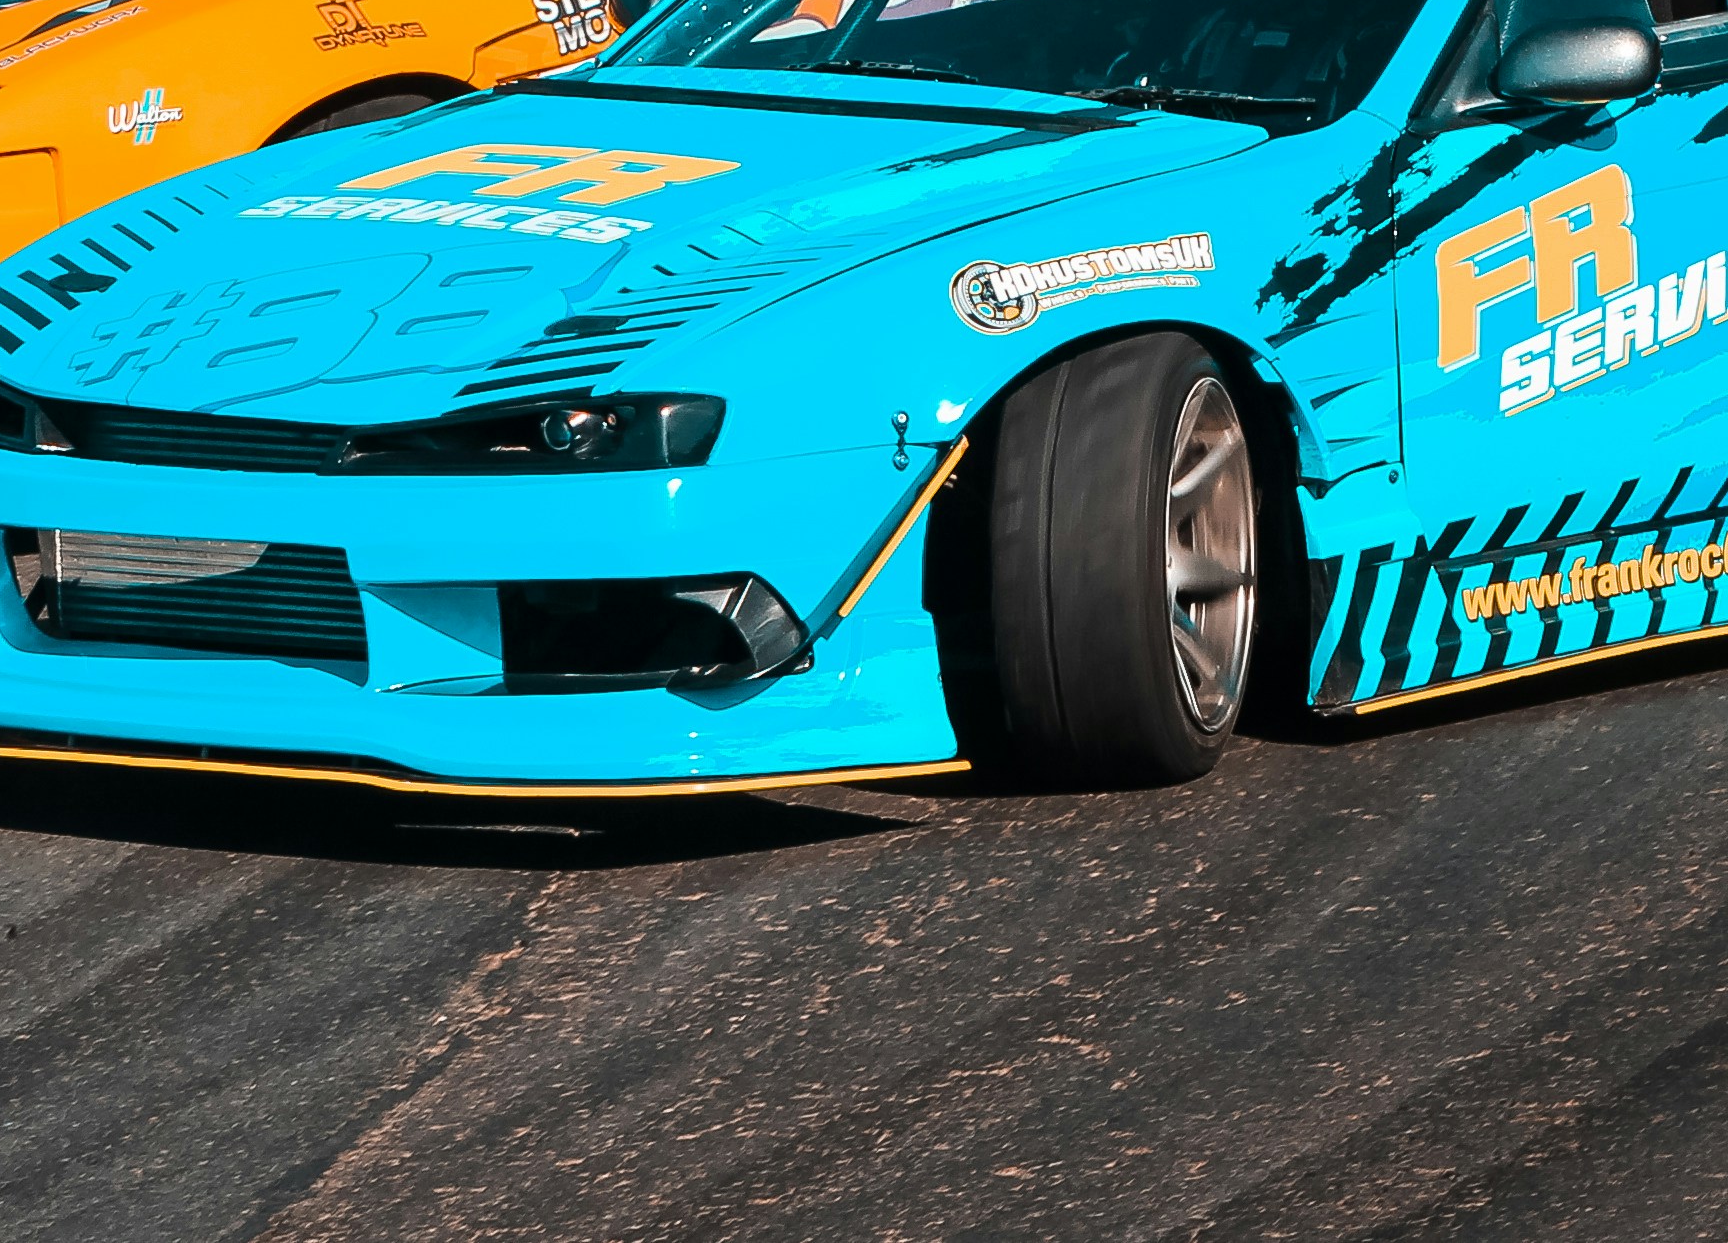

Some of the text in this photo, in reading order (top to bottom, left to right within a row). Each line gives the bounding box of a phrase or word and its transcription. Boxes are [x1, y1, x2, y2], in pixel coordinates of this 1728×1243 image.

[314, 22, 427, 51] DYNATUNE
[108, 100, 183, 134] Walton
[337, 144, 742, 206] FR
[238, 195, 655, 244] SERVICES
[1437, 164, 1635, 370] FR
